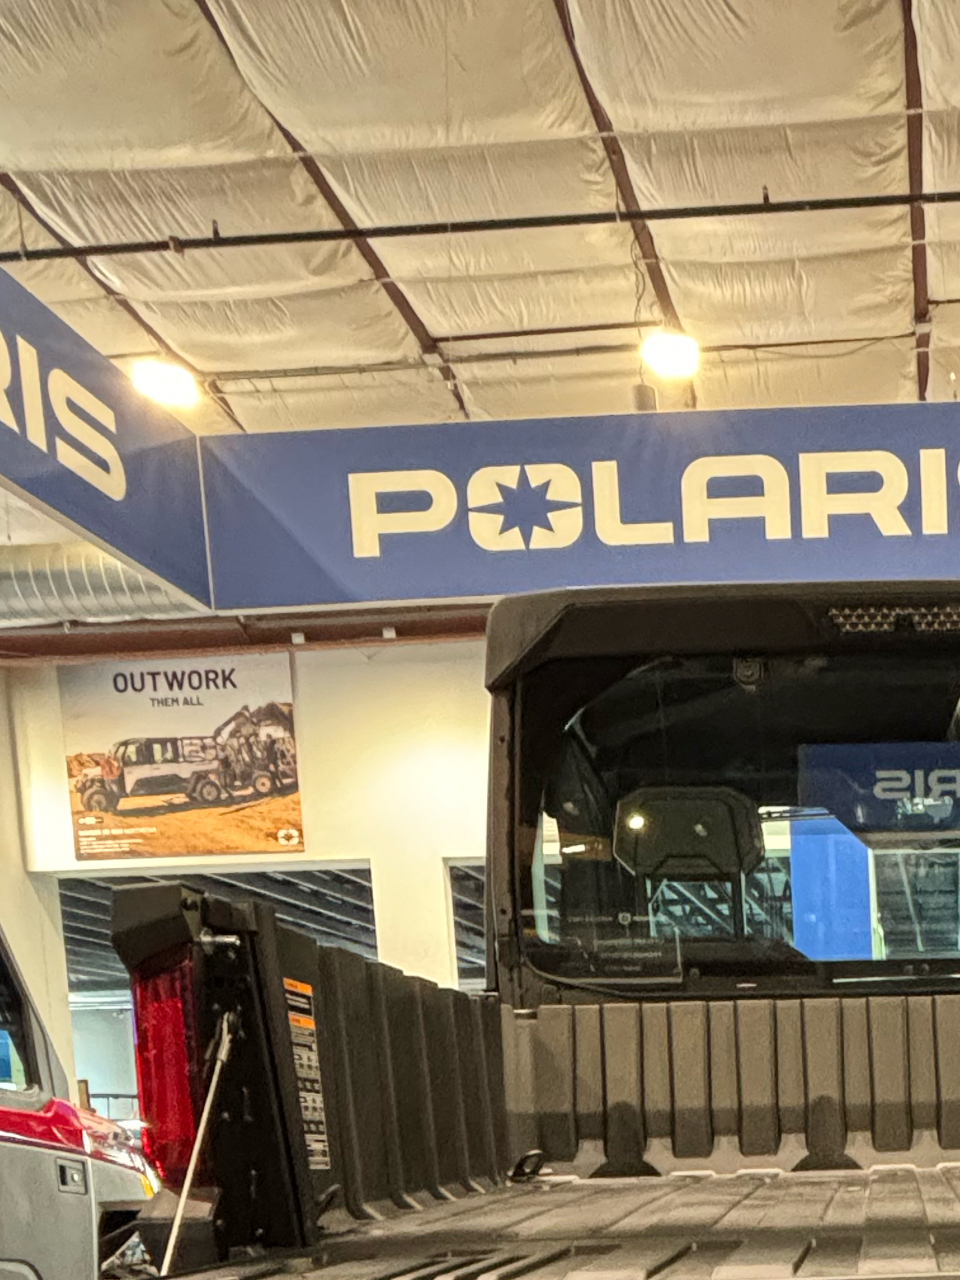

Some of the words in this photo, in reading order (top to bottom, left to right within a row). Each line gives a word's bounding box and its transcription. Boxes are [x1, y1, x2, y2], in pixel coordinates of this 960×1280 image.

[113, 668, 237, 693] OUTWORK
[149, 697, 180, 708] THEM
[182, 695, 204, 706] ALL
